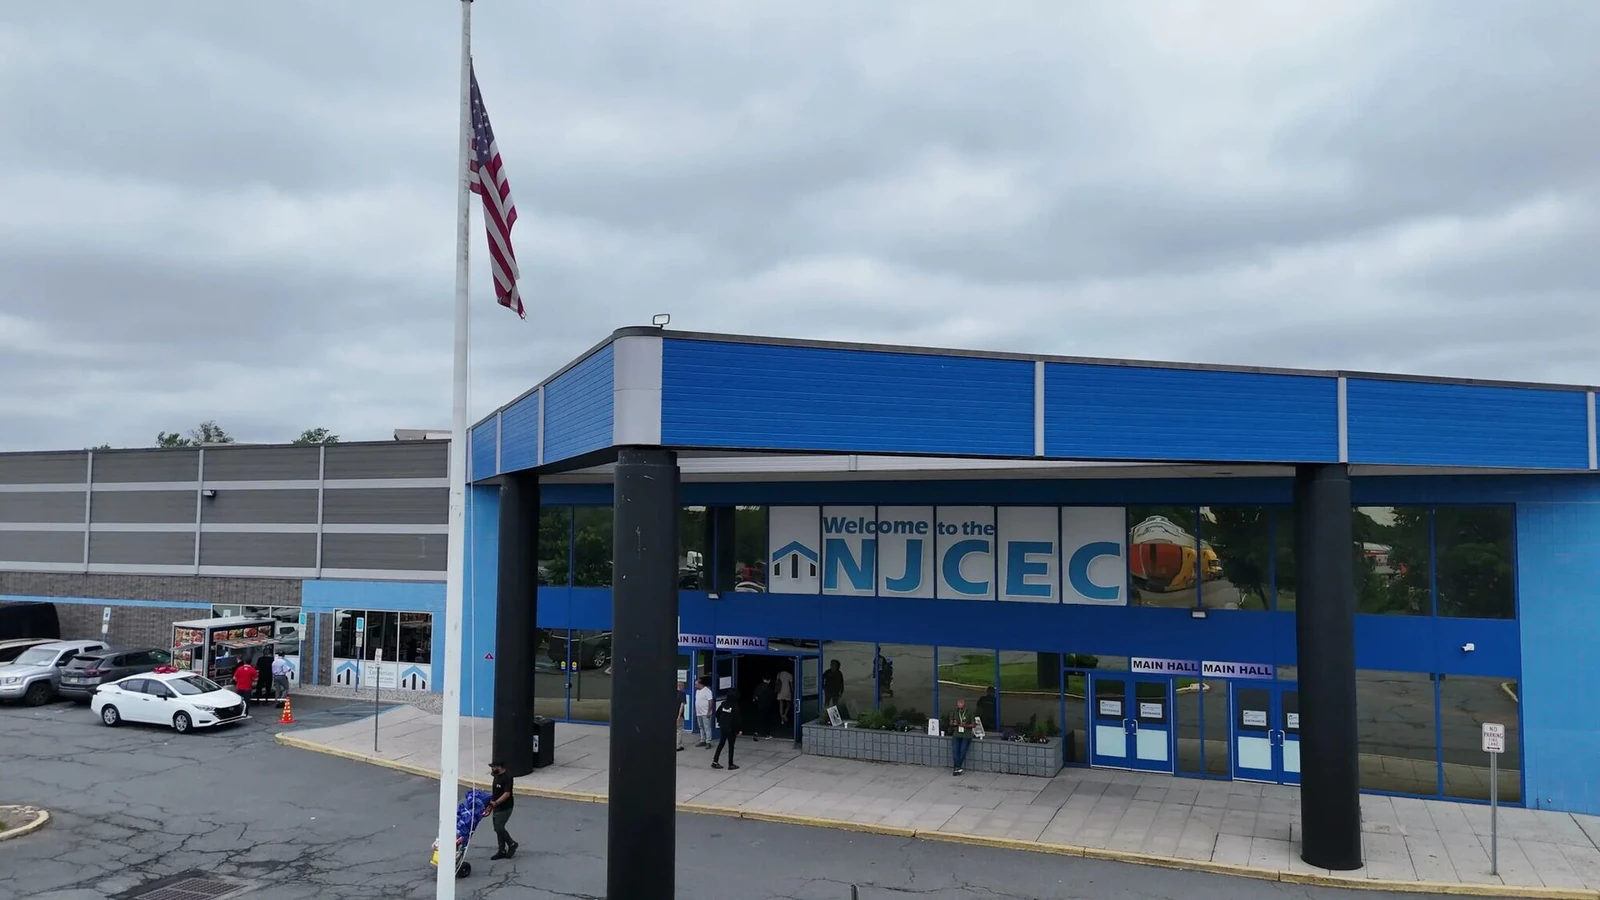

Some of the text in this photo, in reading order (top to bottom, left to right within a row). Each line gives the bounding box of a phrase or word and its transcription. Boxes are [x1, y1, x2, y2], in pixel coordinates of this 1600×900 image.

[823, 516, 995, 536] Welcome to the
[823, 538, 1121, 600] NJCEC
[691, 636, 714, 644] HALL
[717, 637, 765, 647] MAIN HALL
[1133, 660, 1199, 672] MAIN HALL
[1203, 663, 1272, 676] MAIN HALL
